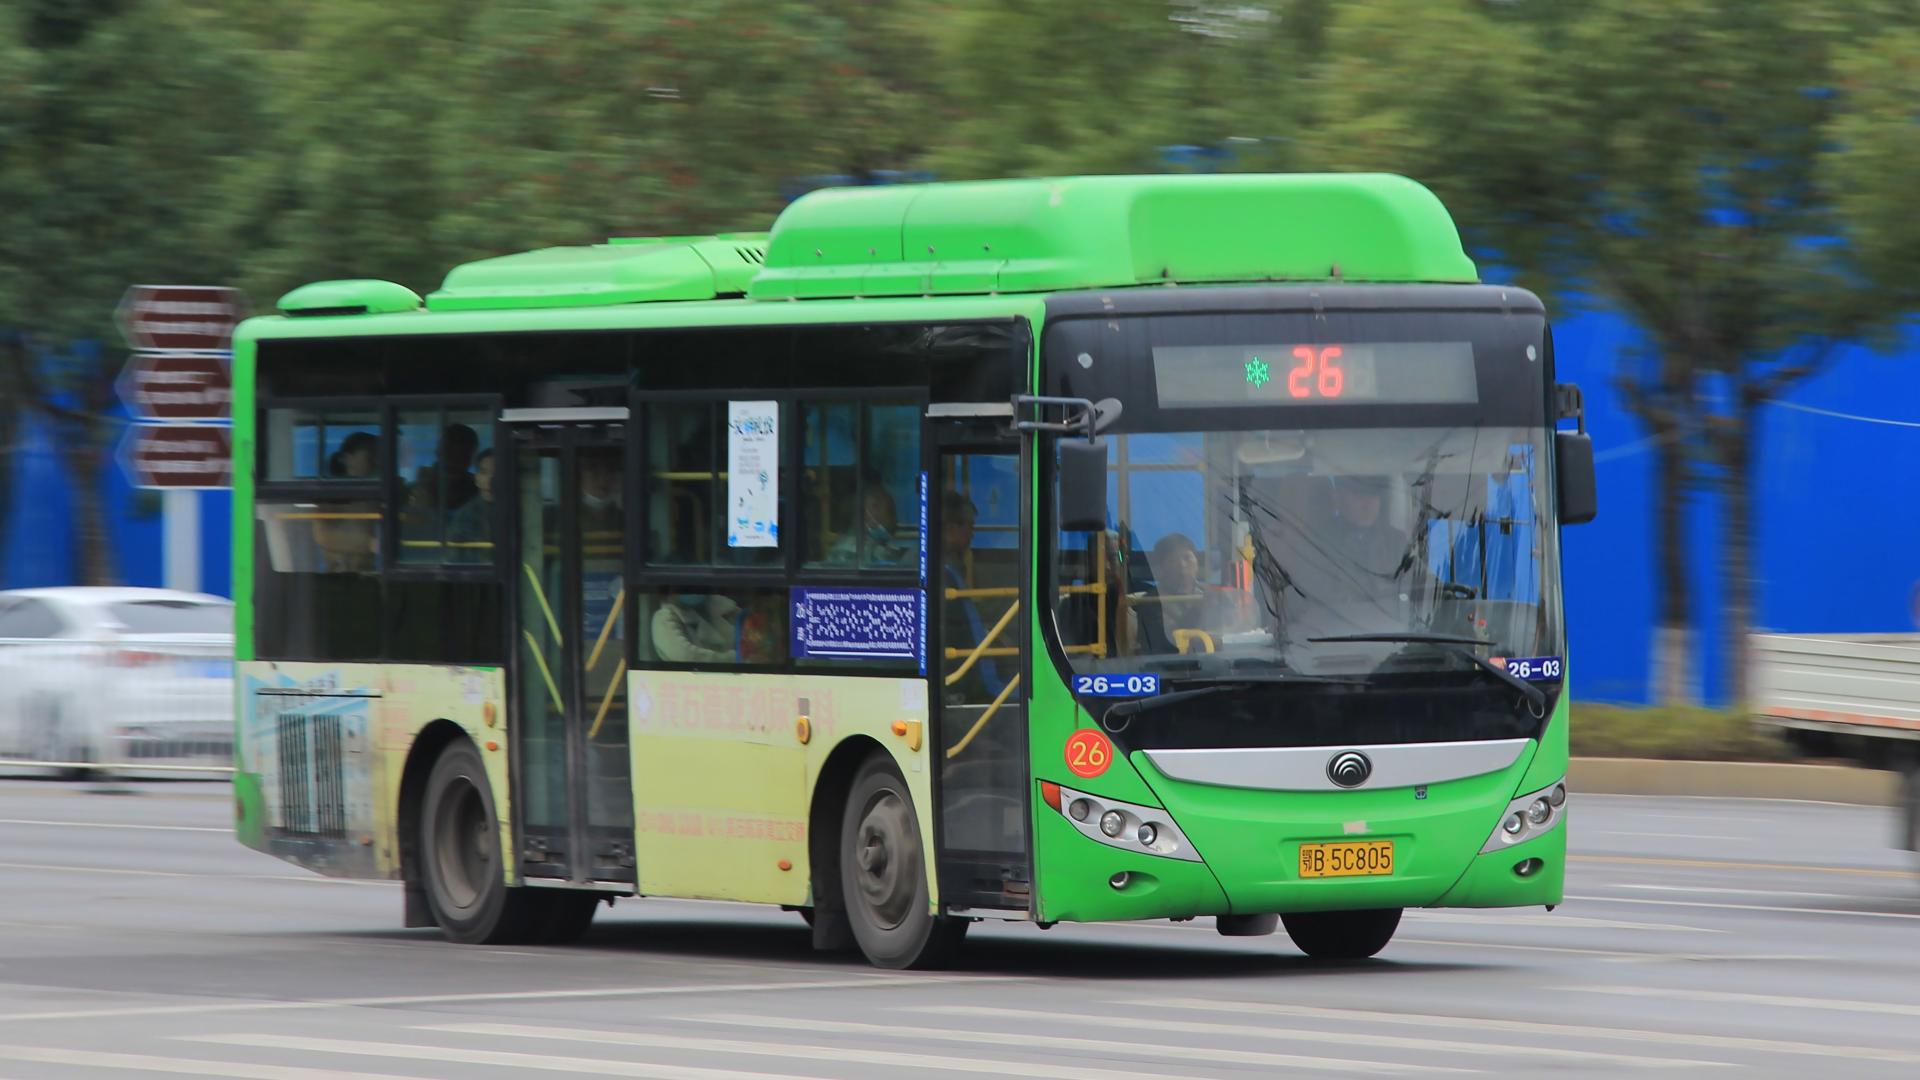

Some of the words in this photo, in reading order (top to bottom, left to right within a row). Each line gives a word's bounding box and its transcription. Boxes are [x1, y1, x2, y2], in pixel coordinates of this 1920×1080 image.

[1288, 346, 1344, 398] 26
[1508, 660, 1560, 679] 26-03
[1078, 676, 1156, 694] 26-03
[1072, 741, 1105, 767] 26
